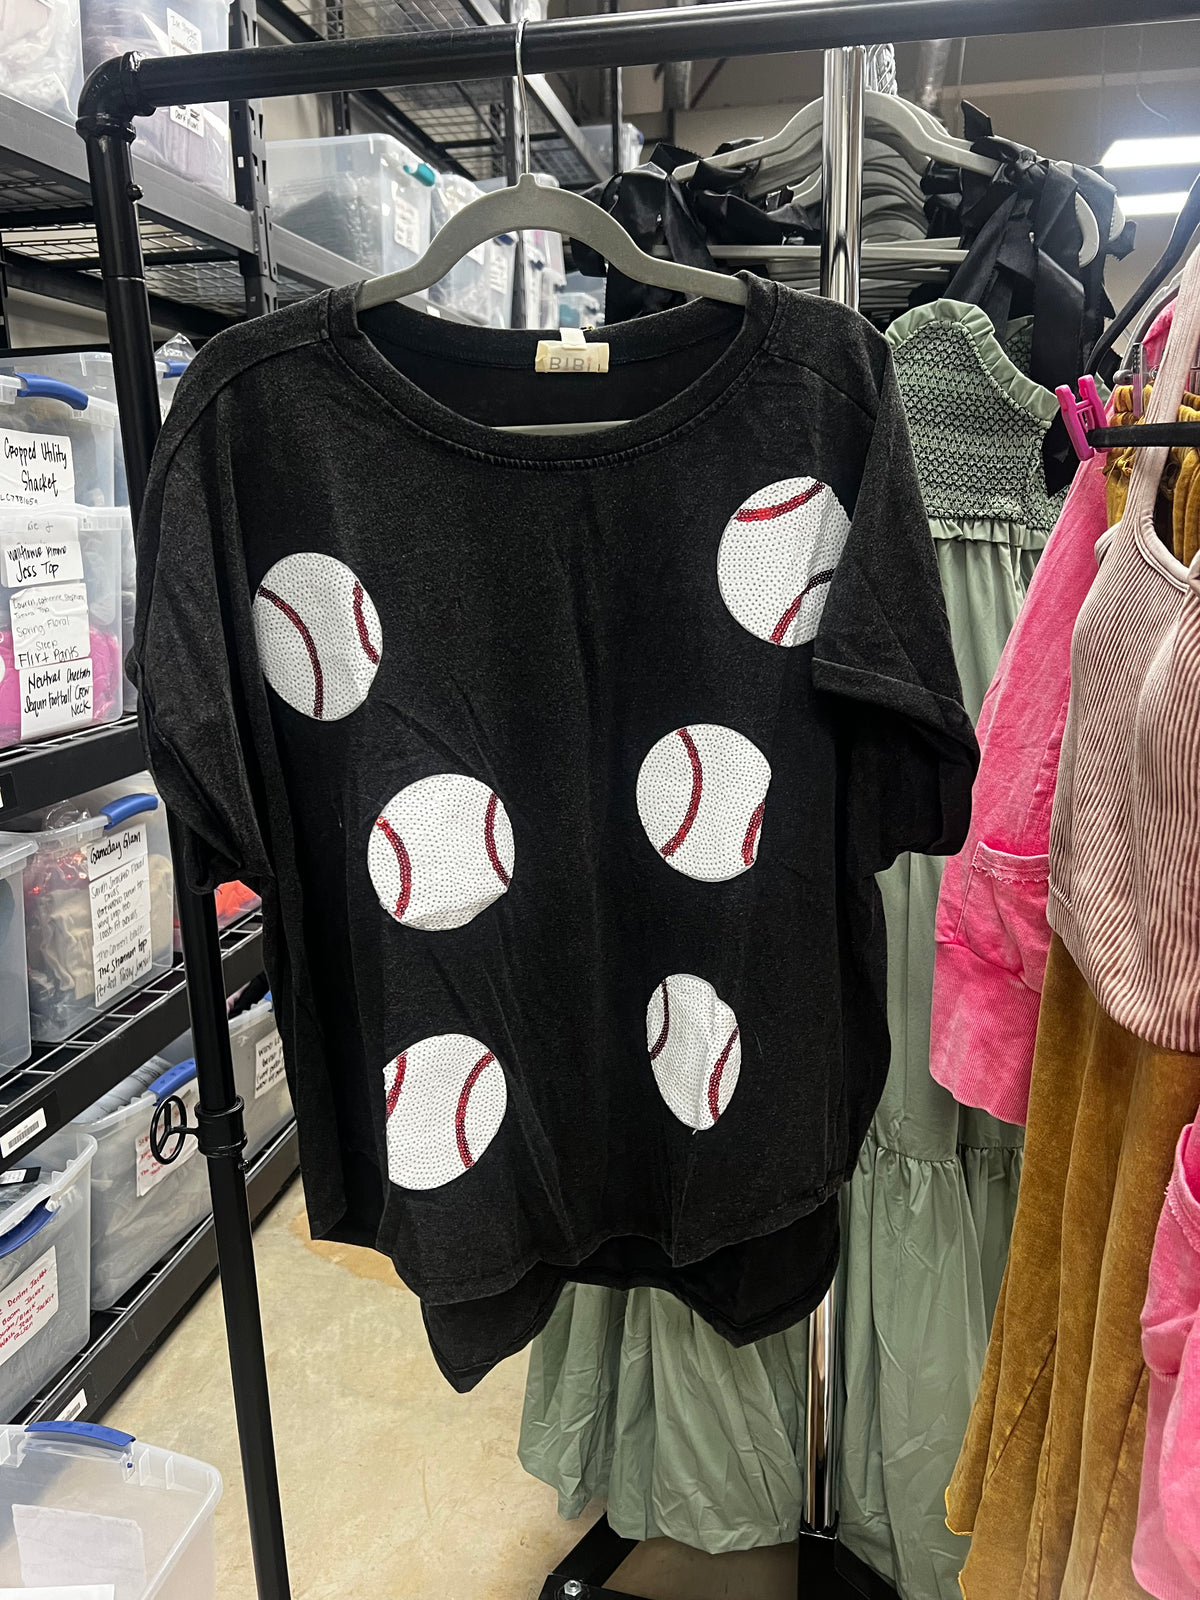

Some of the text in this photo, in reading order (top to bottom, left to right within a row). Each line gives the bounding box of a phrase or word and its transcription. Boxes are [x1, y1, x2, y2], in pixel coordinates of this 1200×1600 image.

[4, 436, 67, 470] Cropped Utility
[21, 469, 58, 497] Shacket
[16, 560, 59, 582] Jess Top
[16, 616, 70, 638] Spring Floral
[18, 645, 80, 668] Flirt Pants
[35, 640, 58, 652] Sleep
[28, 669, 61, 694] Neutral
[48, 684, 72, 709] Football
[70, 700, 91, 718] Neck
[90, 831, 141, 865] Gameday Glam
